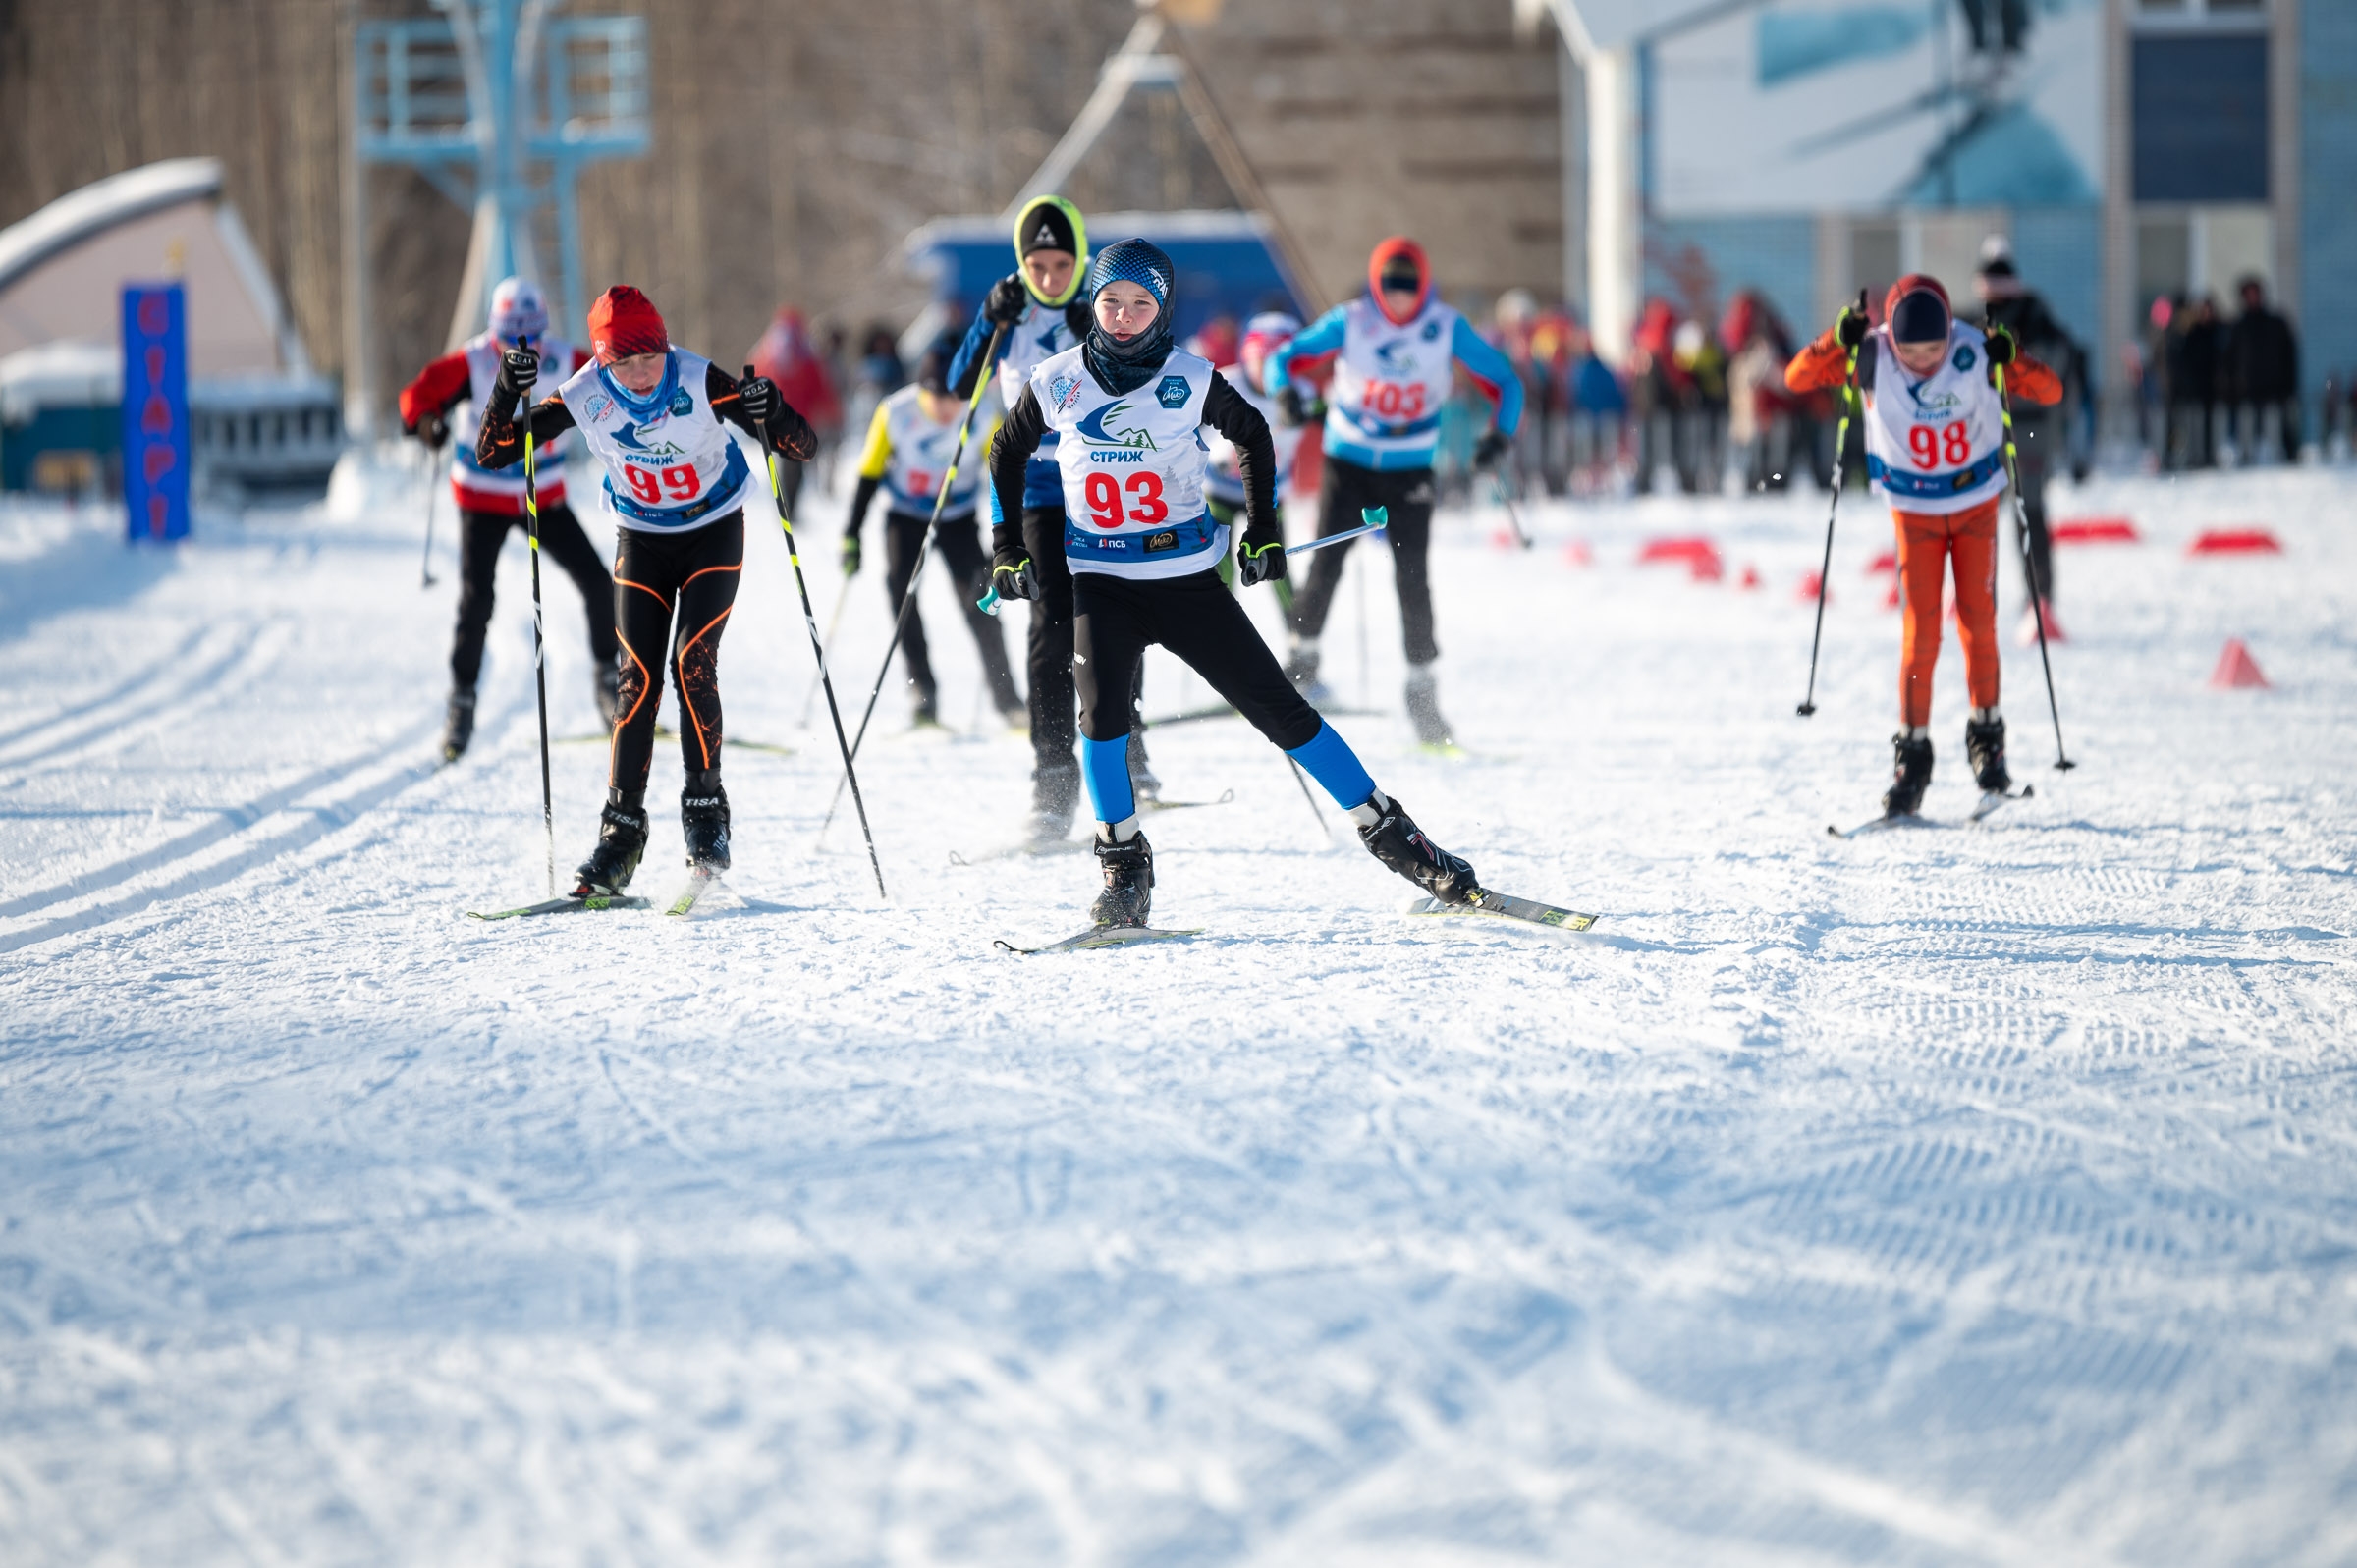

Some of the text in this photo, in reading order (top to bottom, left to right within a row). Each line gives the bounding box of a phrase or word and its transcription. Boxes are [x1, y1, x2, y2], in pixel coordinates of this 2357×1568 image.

[1909, 419, 1971, 473] 98
[1090, 450, 1144, 463] СТРИЖ
[624, 462, 701, 505] 99
[1084, 470, 1169, 529] 93
[1108, 539, 1126, 549] ПСБ
[685, 797, 719, 806] TISA
[609, 810, 640, 829] TISA
